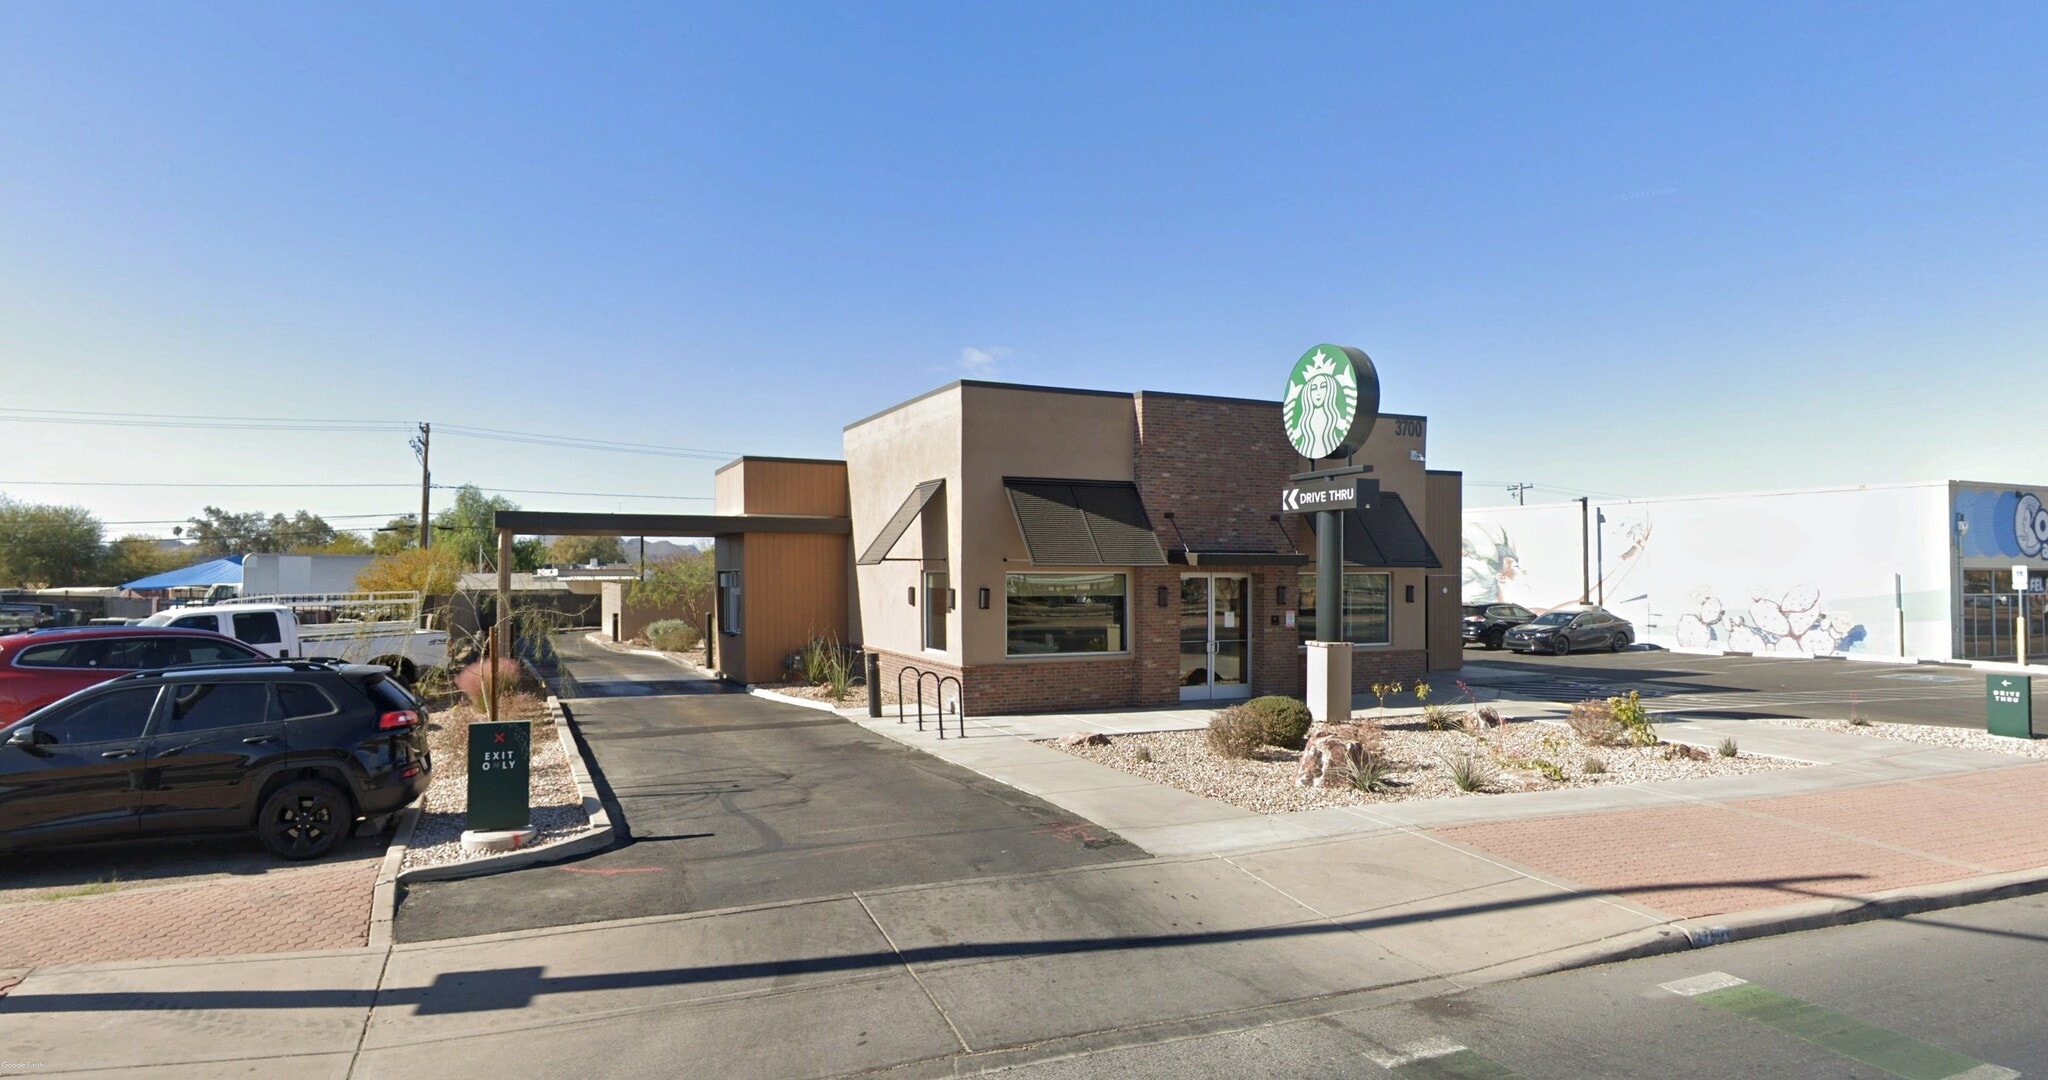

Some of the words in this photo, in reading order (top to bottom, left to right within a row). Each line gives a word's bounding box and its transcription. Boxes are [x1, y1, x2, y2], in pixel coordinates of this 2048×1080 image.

[1395, 420, 1422, 437] 3700
[1300, 491, 1327, 504] DRIVE
[1328, 487, 1354, 501] THRU
[1995, 695, 2019, 703] THRU
[484, 751, 514, 761] EXIT
